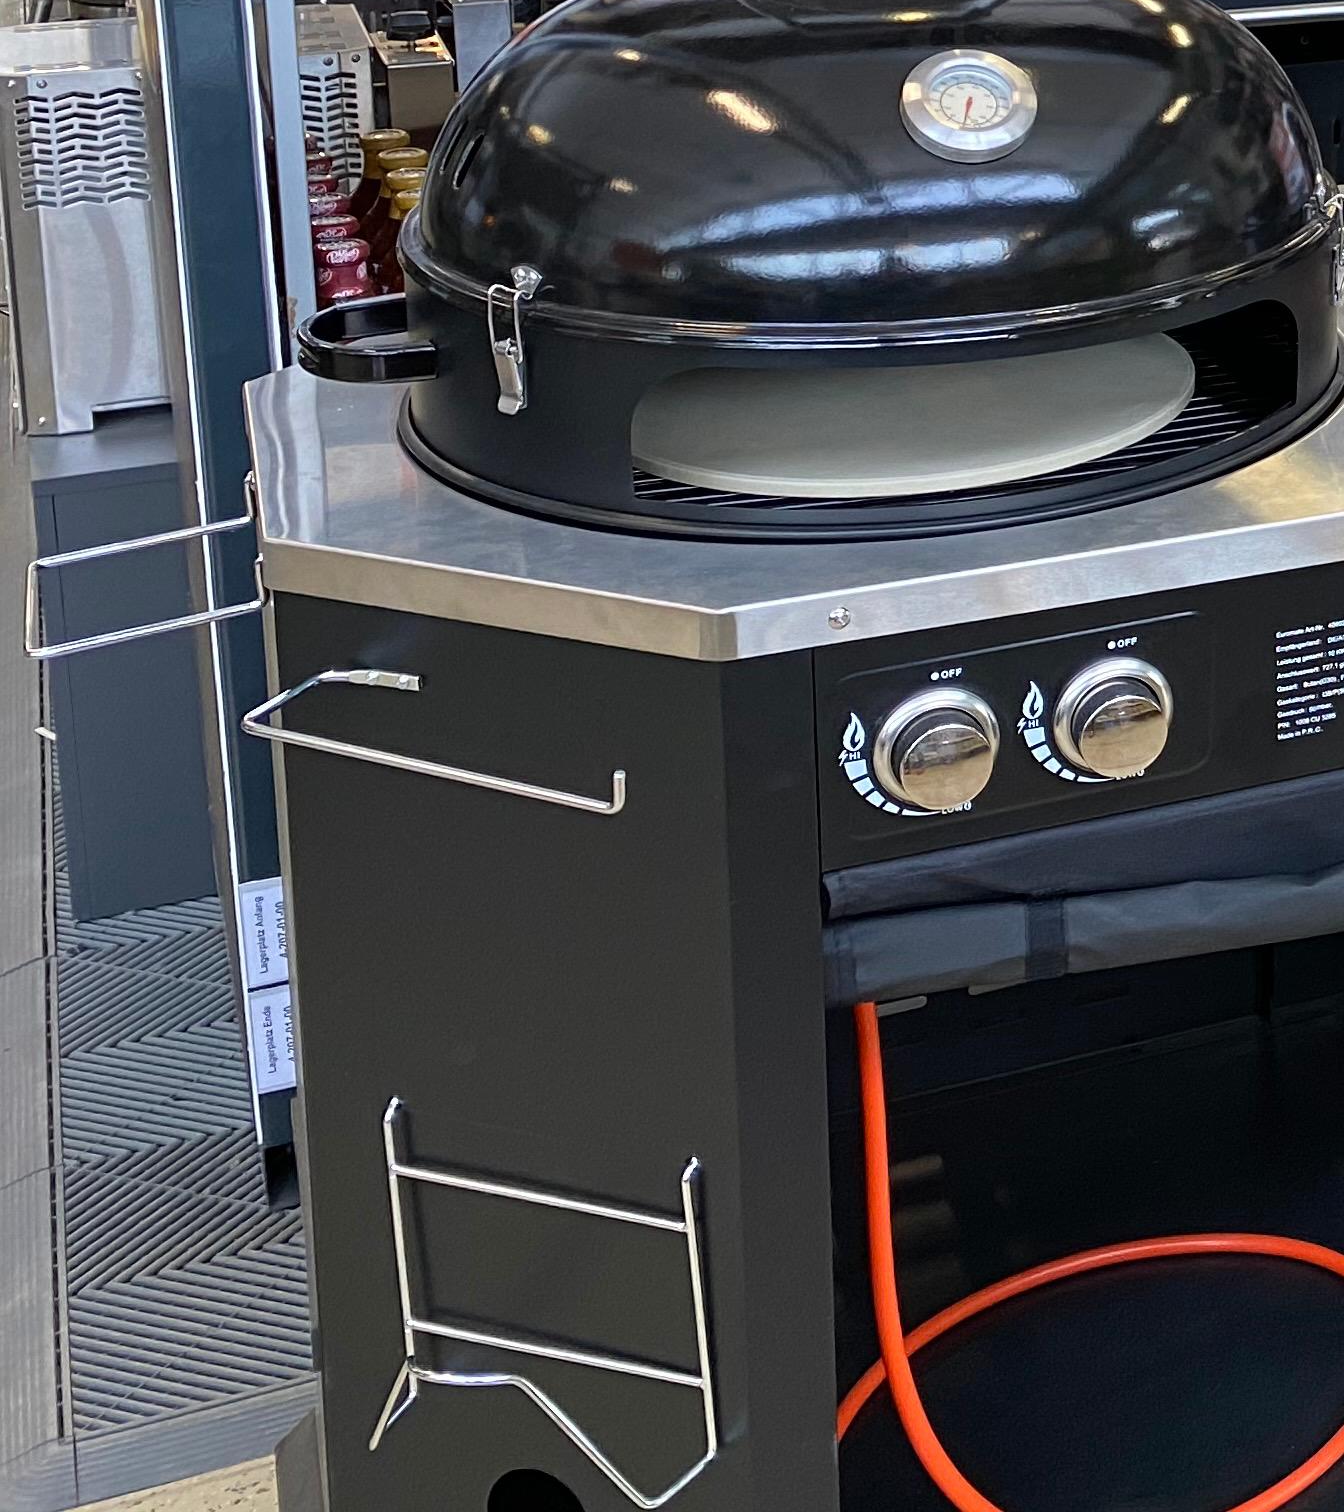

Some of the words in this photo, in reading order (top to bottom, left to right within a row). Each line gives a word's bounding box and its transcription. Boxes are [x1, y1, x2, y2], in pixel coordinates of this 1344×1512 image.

[1117, 637, 1138, 648] OFF
[940, 667, 963, 679] OFF
[1028, 719, 1039, 728] HI
[849, 751, 861, 761] HI
[256, 928, 269, 974] Lagerplatz
[263, 1005, 272, 1028] Ende
[263, 1029, 277, 1075] Lagerplatz
